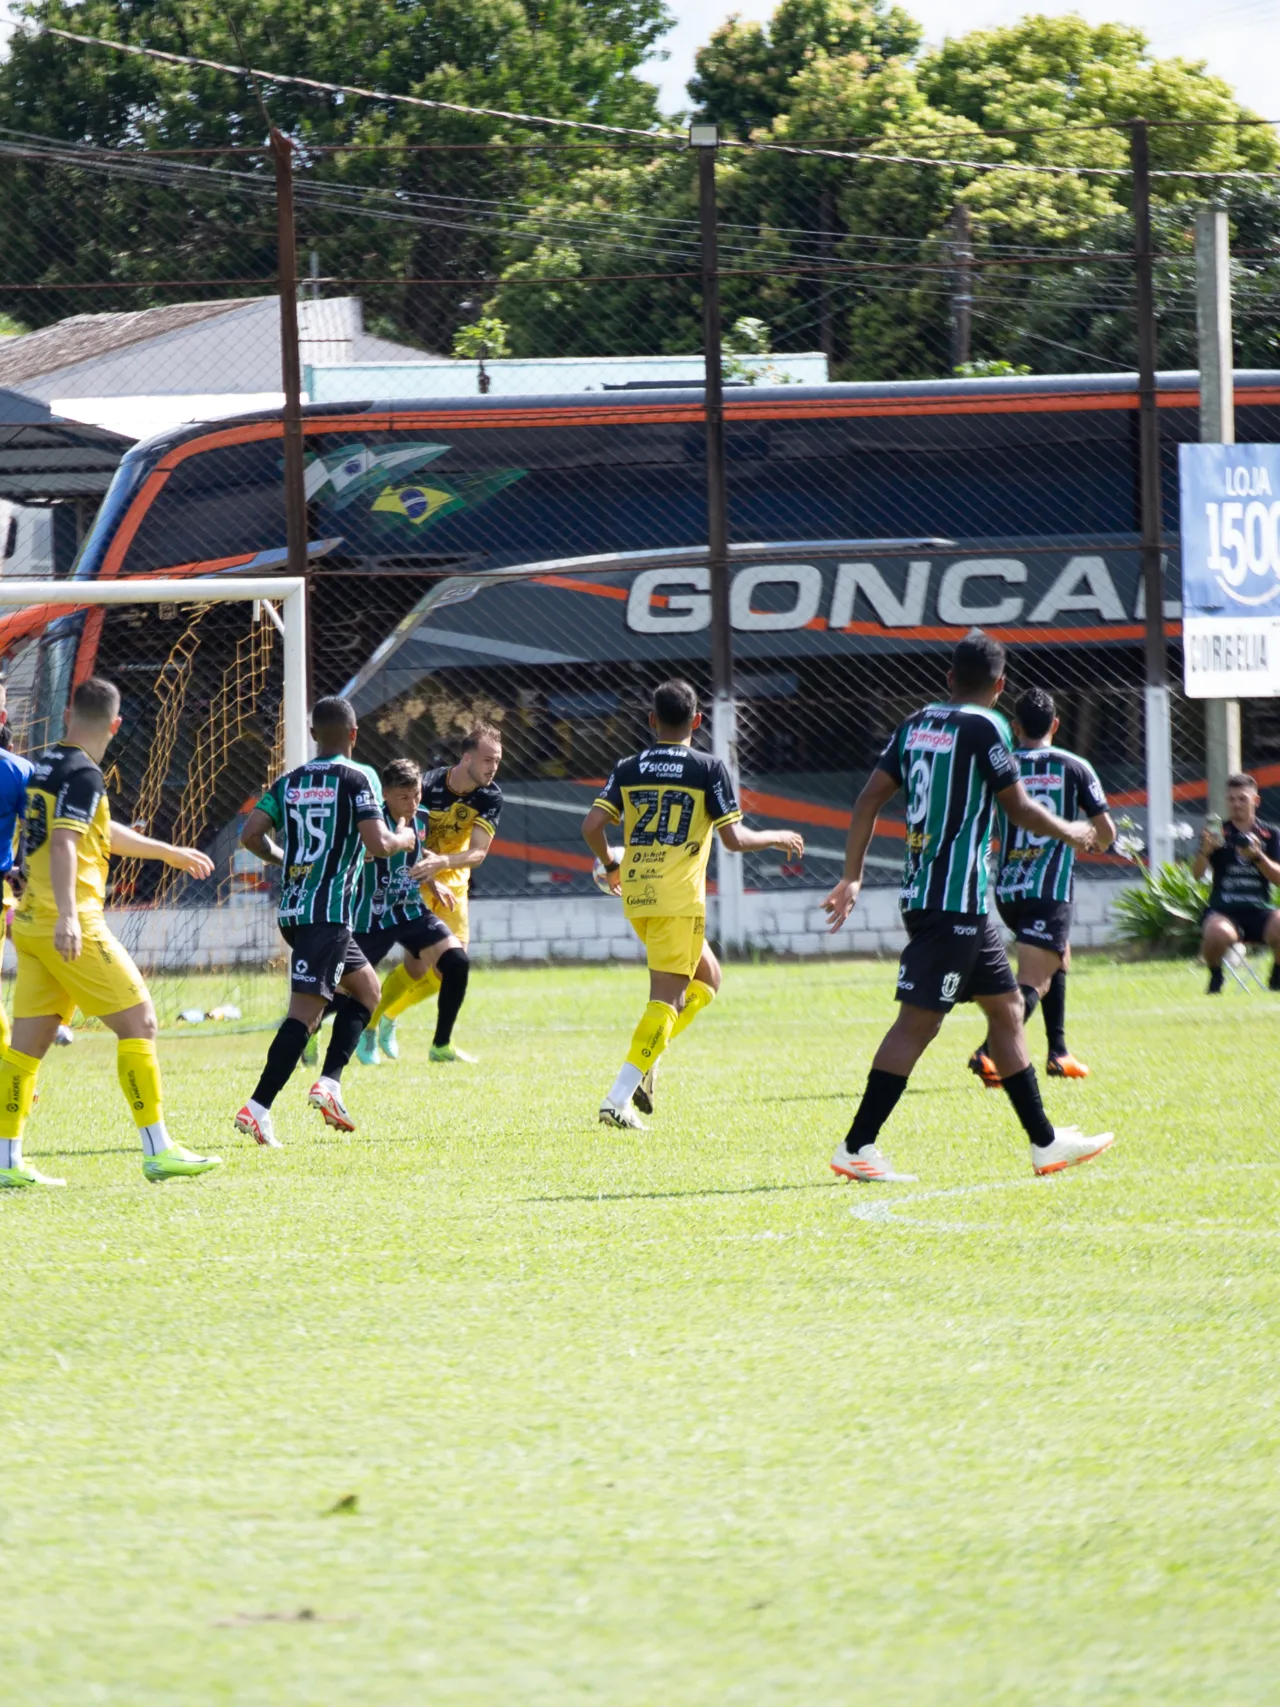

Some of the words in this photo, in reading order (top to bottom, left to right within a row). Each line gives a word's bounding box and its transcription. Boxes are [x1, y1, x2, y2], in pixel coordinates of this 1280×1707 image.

[1225, 465, 1272, 497] LOJA
[648, 763, 684, 773] SICOOB
[303, 786, 336, 800] amigão
[907, 760, 930, 825] 3
[289, 808, 331, 865] 15
[628, 789, 694, 847] 20
